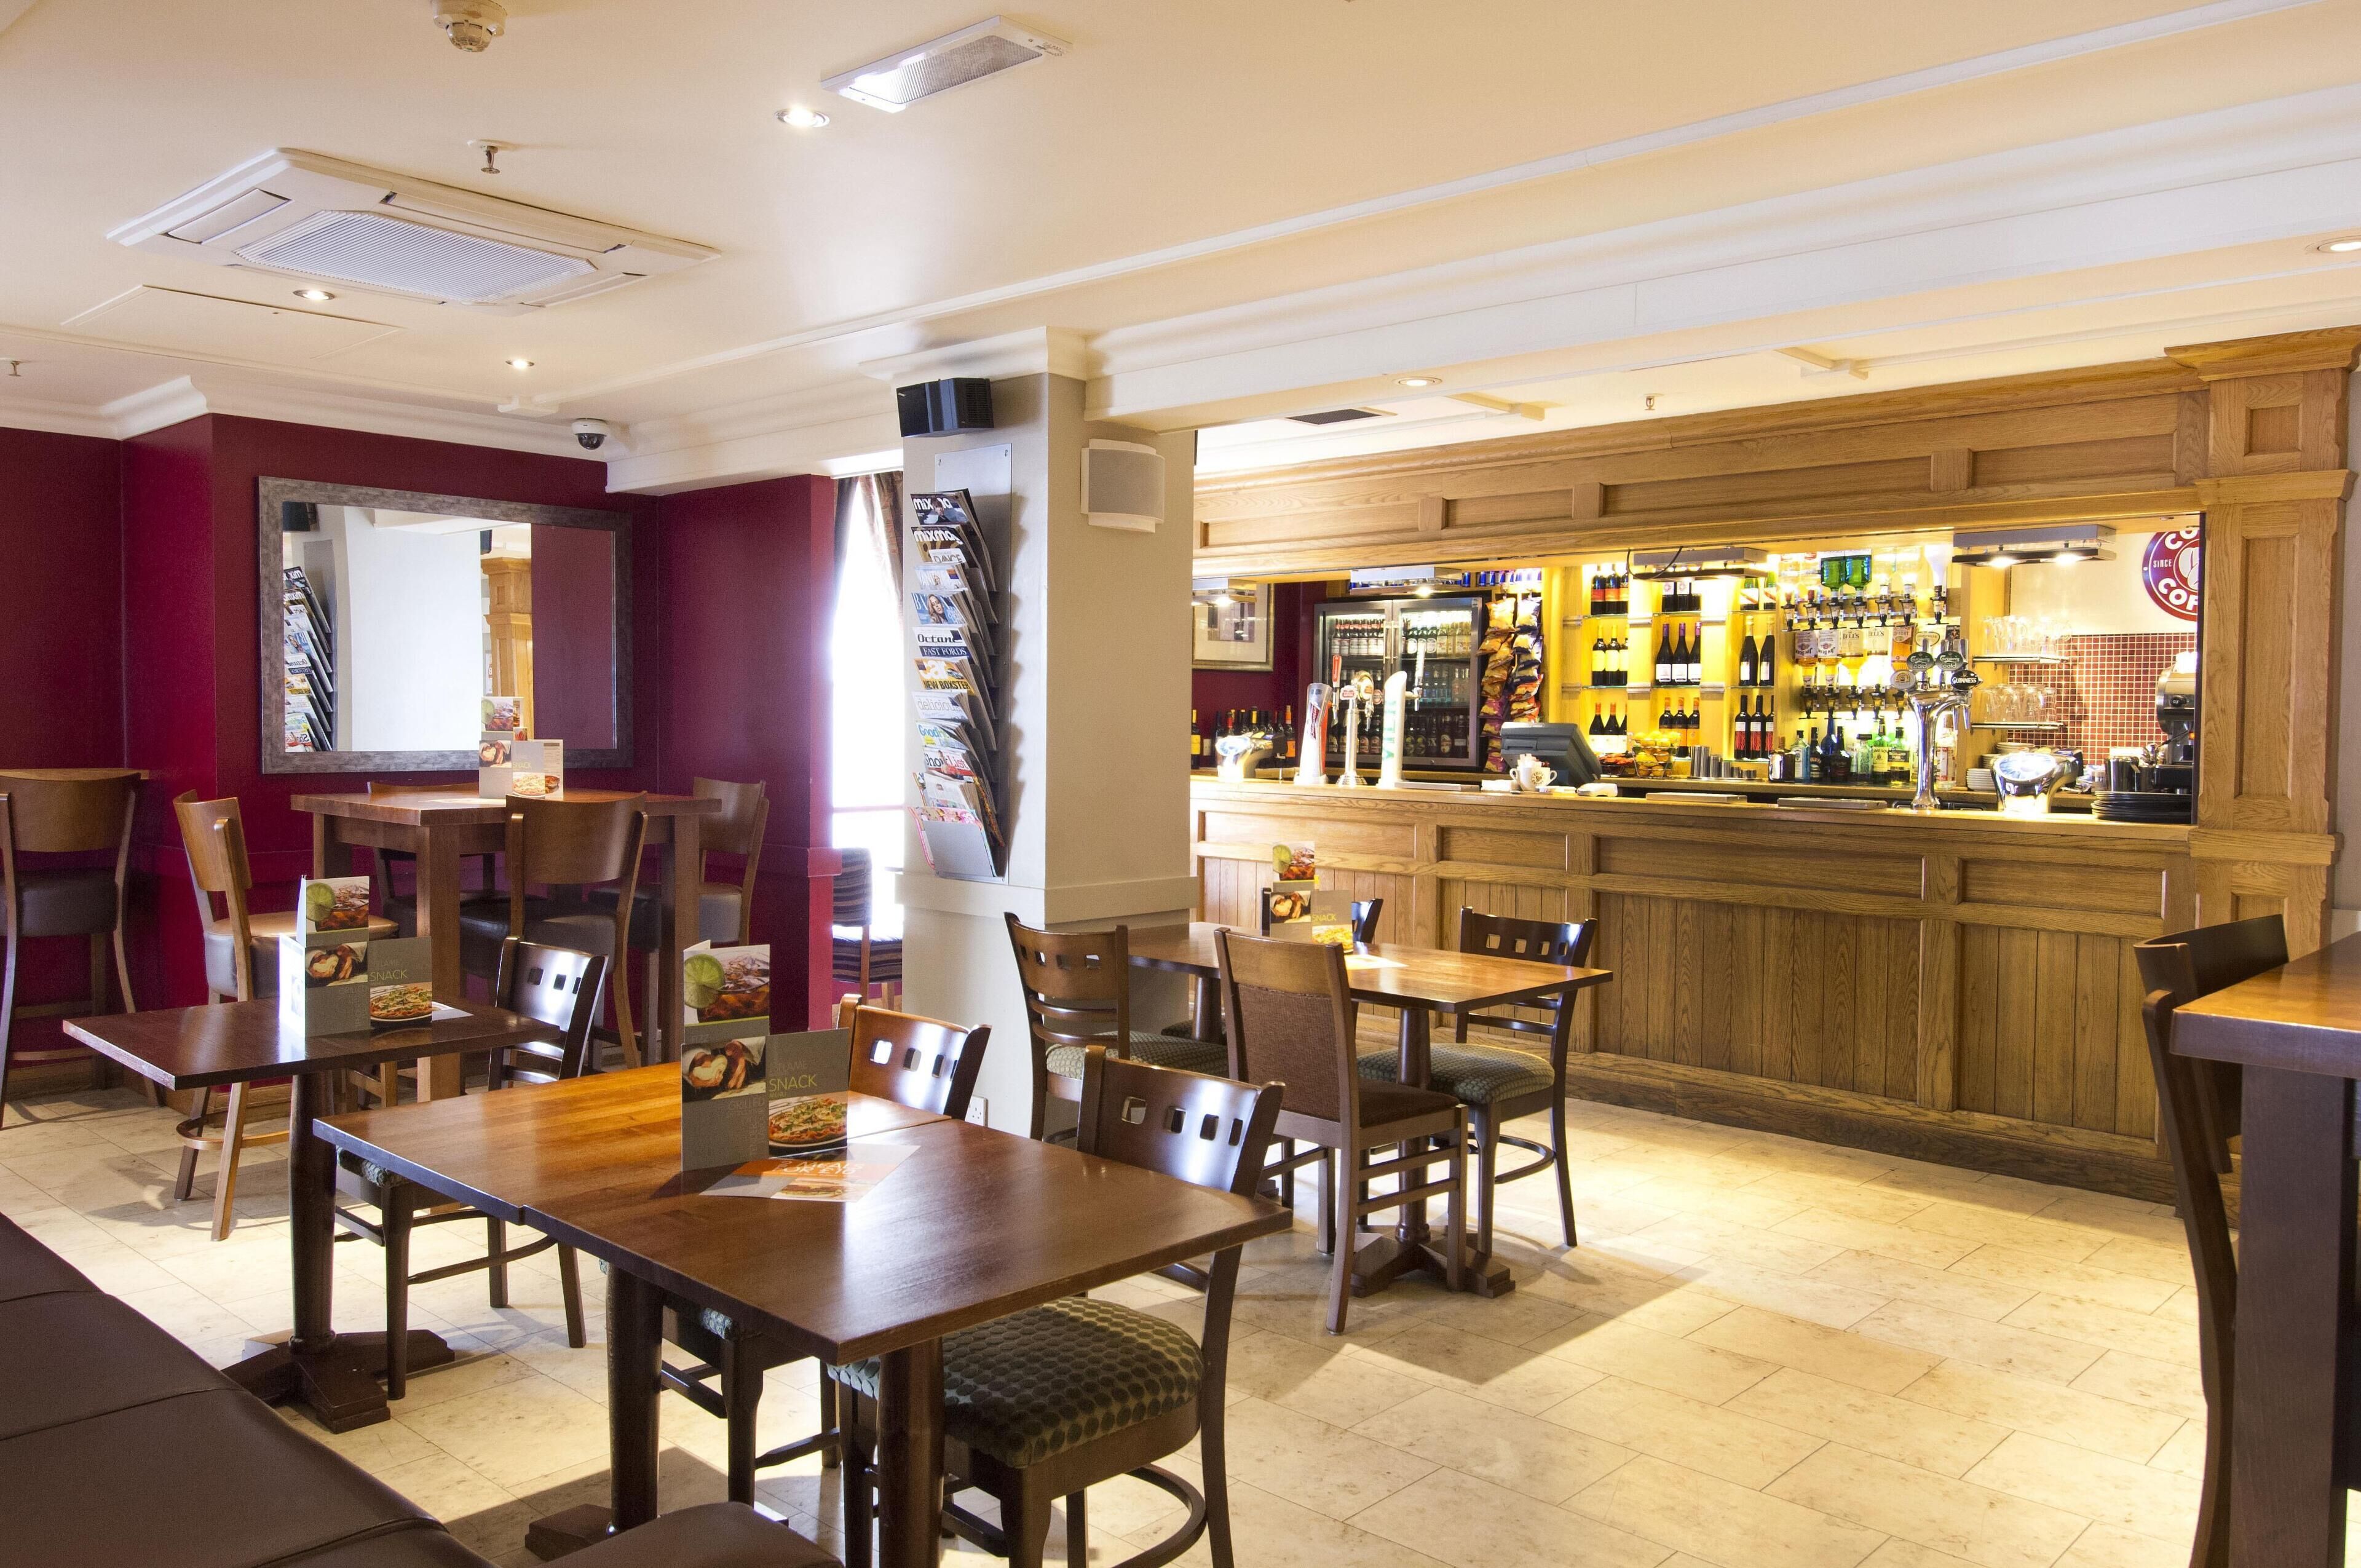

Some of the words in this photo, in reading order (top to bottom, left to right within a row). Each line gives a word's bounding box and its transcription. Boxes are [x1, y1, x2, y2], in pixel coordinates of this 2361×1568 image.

[2153, 559, 2172, 568] SINCE
[938, 681, 971, 689] BOXSTER
[369, 969, 408, 981] SNACK
[769, 1074, 817, 1092] SNACK
